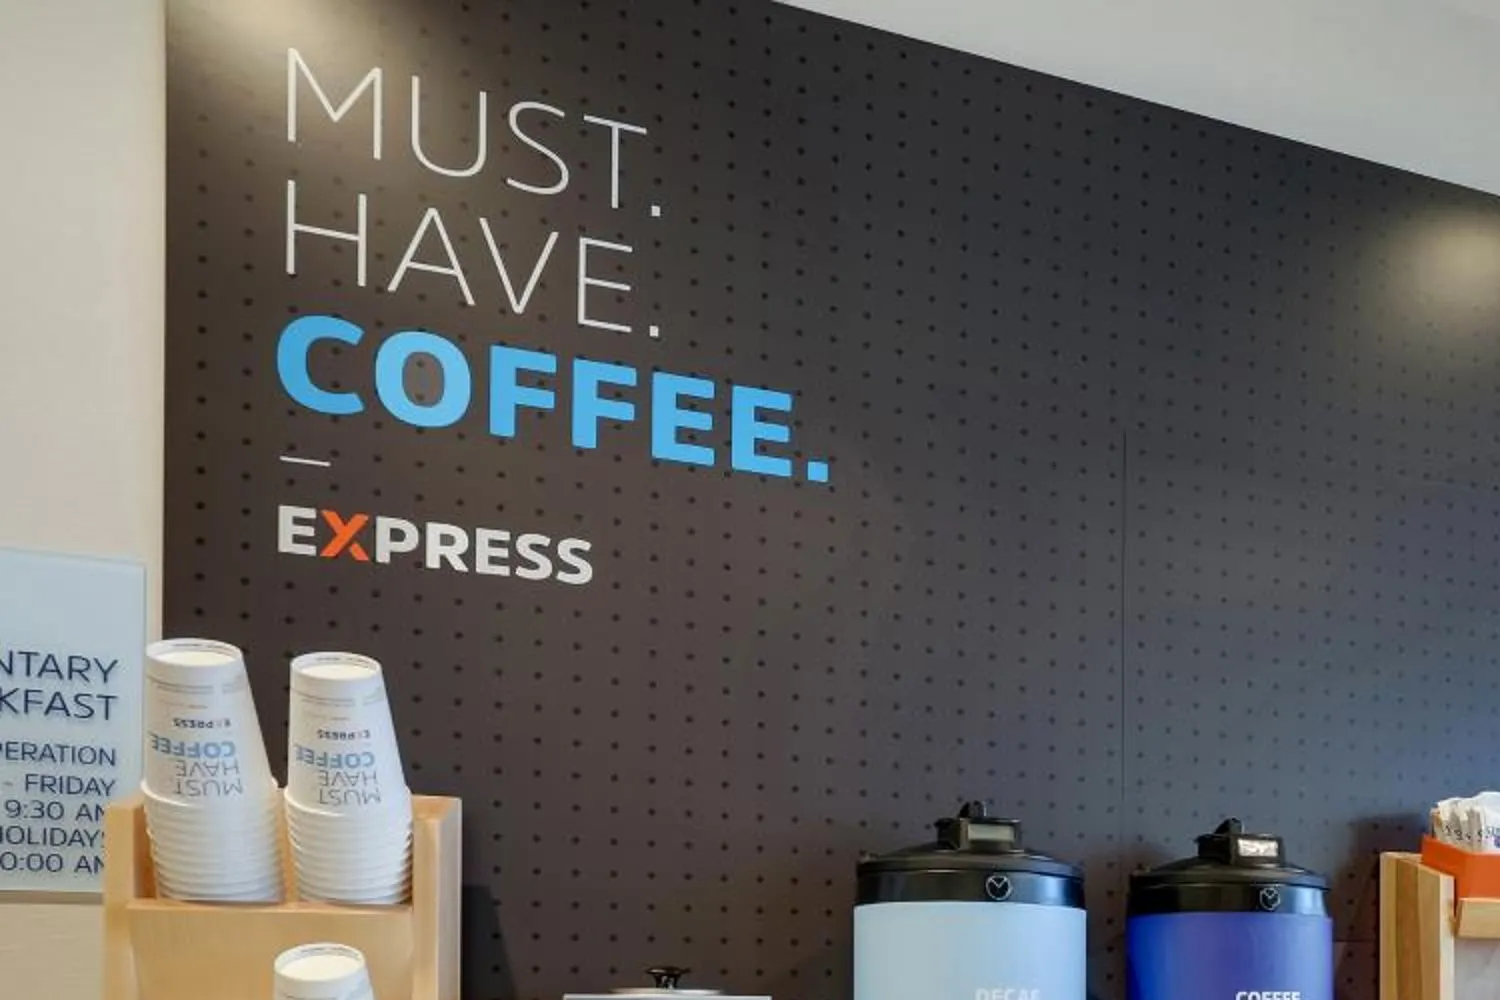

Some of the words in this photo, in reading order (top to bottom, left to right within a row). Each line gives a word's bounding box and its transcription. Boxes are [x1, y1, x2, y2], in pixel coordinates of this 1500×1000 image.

[286, 46, 662, 218] MUST.
[285, 178, 660, 338] HAVE.
[276, 314, 830, 483] COFFEE.
[277, 504, 594, 586] EXPRESS
[0, 650, 119, 684] NTARY
[0, 686, 119, 721] KFAST
[149, 731, 237, 760] COFFEE
[295, 744, 376, 769] COFFEE
[175, 758, 241, 777] HAVE
[318, 769, 378, 787] HAVE
[25, 773, 117, 797] FRIDAY
[174, 776, 244, 797] MUST
[319, 788, 382, 806] MUST
[4, 799, 65, 821] 9:30
